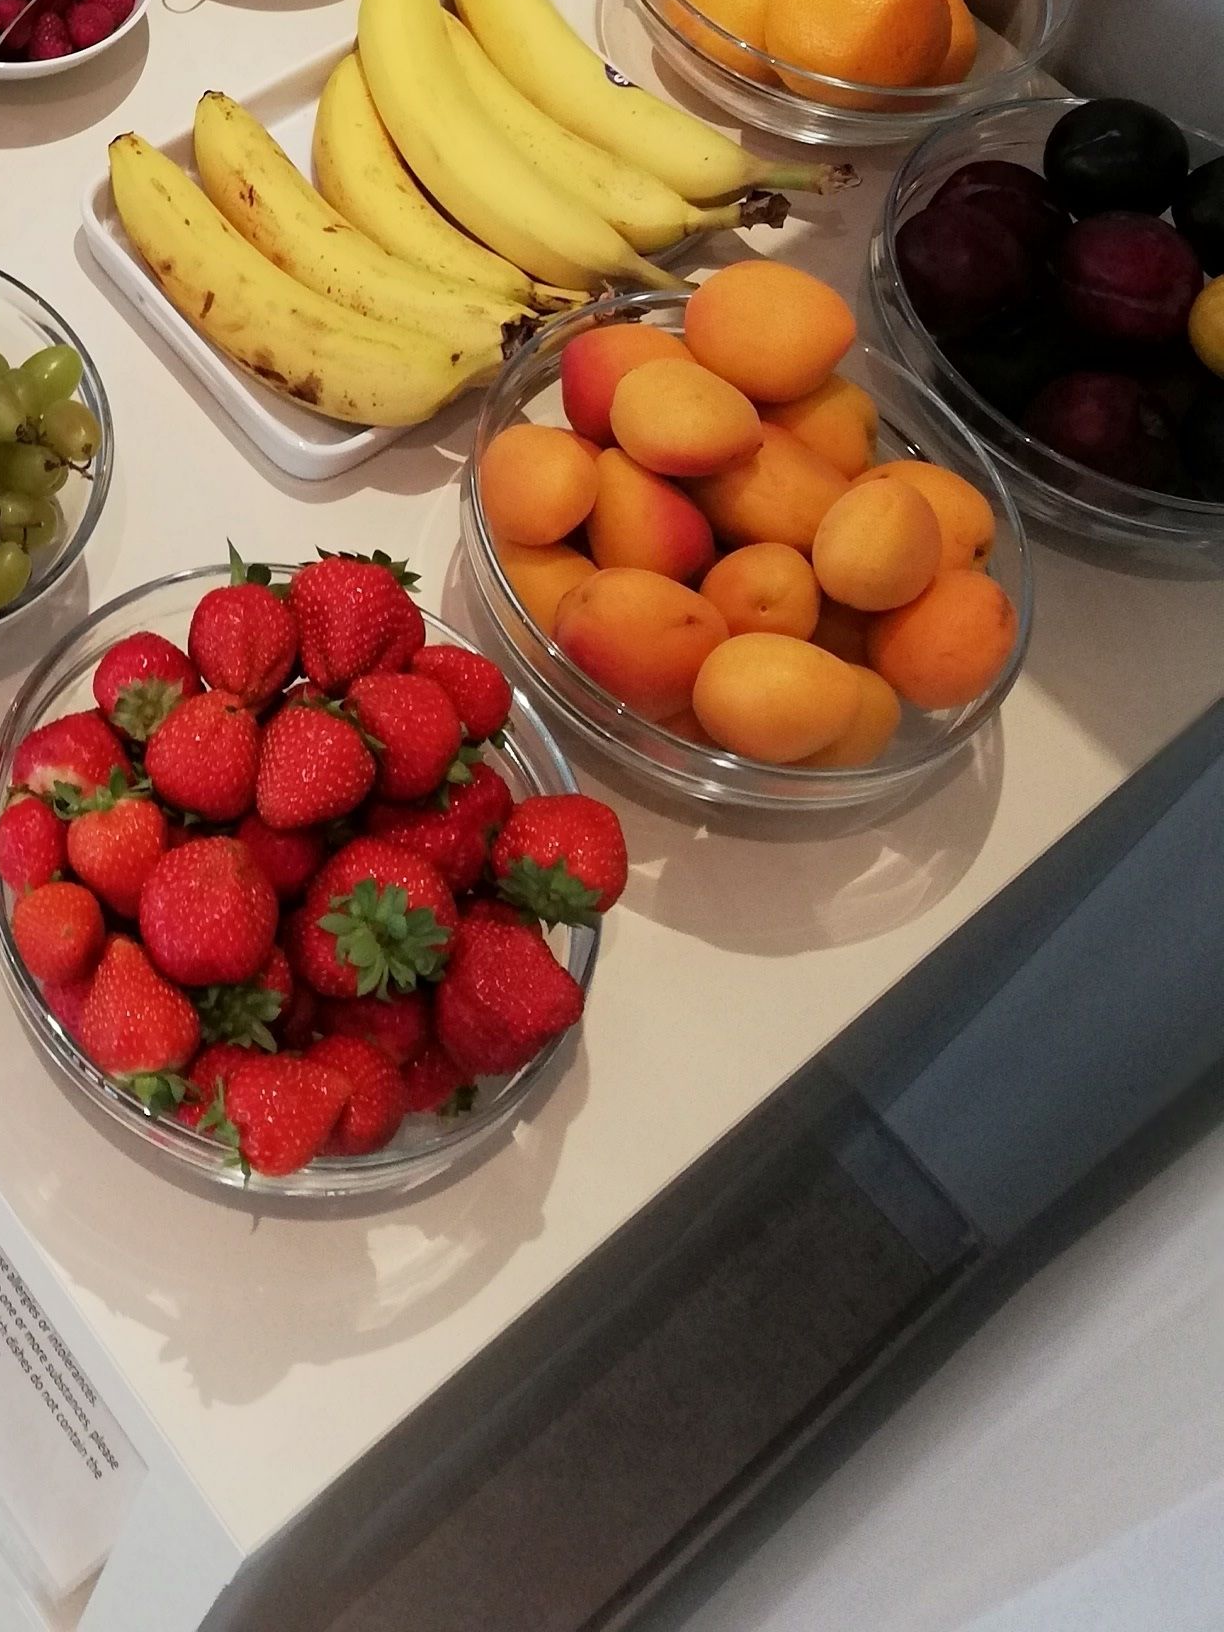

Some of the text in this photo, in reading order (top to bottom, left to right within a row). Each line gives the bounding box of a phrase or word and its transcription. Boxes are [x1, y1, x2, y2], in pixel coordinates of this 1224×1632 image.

[7, 1272, 40, 1319] allergies
[38, 1319, 50, 1332] or
[0, 1294, 17, 1317] one
[15, 1317, 27, 1330] or
[25, 1331, 47, 1364] more
[88, 1430, 119, 1470] please
[6, 1336, 32, 1374] dishes
[30, 1373, 44, 1391] do
[41, 1391, 58, 1414] not
[56, 1413, 87, 1458] contain
[86, 1456, 102, 1480] the
